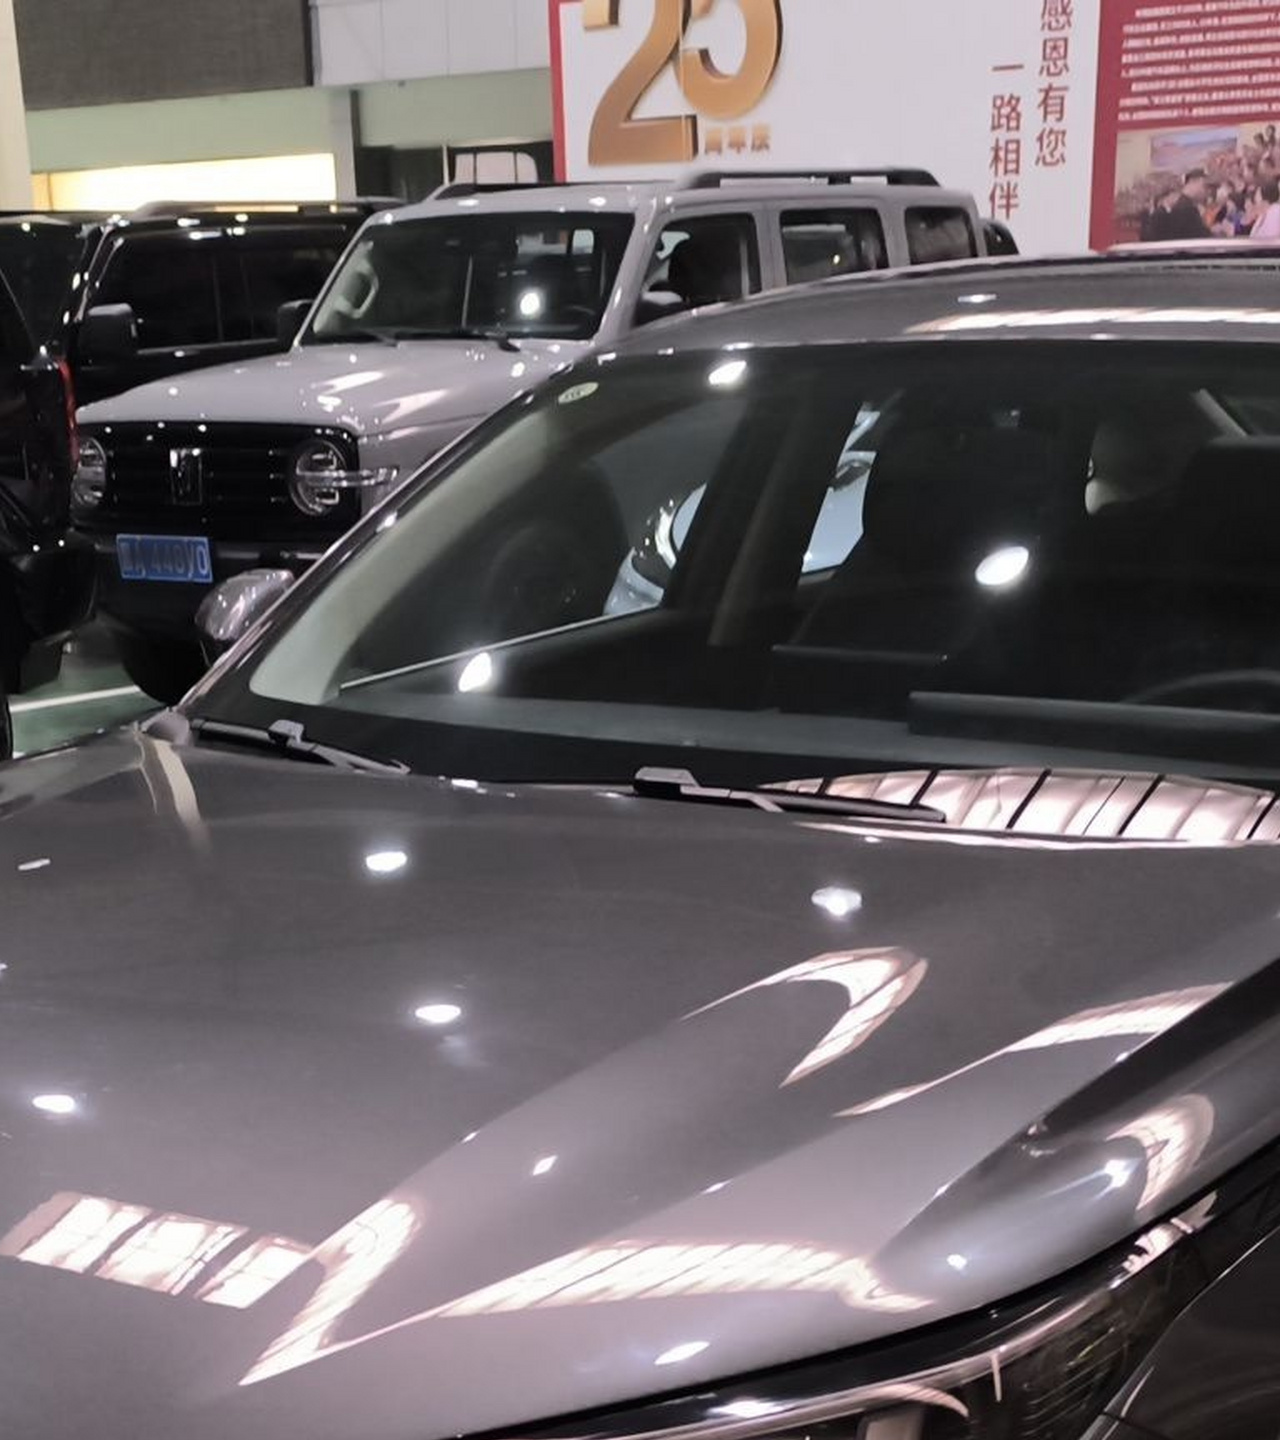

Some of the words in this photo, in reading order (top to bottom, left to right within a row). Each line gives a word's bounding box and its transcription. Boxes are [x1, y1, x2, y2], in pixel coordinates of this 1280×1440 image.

[989, 64, 1024, 220] 一路相伴
[1035, 0, 1073, 167] 感恩有您
